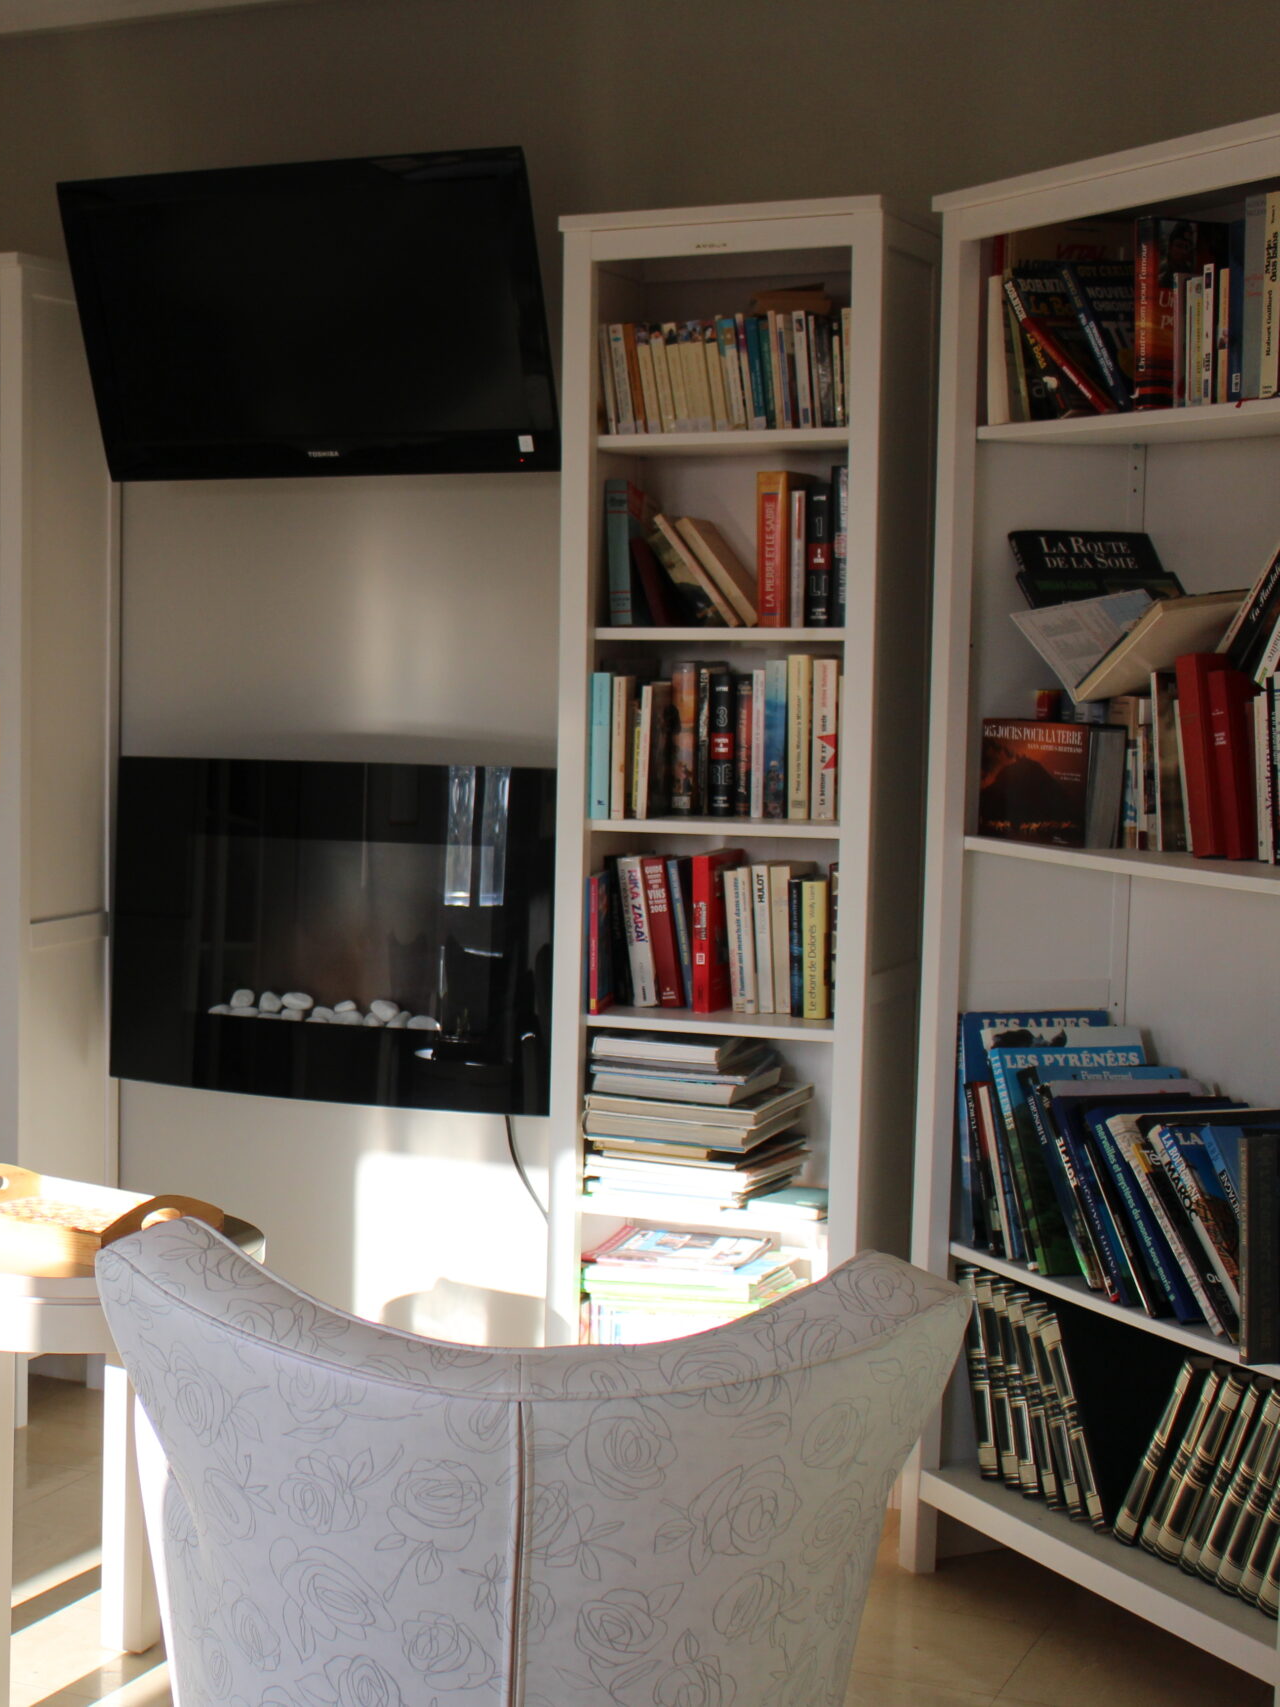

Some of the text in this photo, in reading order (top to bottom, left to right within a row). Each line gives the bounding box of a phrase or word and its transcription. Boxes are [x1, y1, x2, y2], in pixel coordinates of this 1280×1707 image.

[1137, 243, 1148, 279] l'amour
[1138, 282, 1149, 305] pour
[1138, 330, 1148, 356] autre
[765, 535, 775, 545] LE
[1040, 536, 1132, 554] LA ROUTE
[765, 547, 775, 558] ET
[1045, 553, 1139, 570] DE LA SOIE
[765, 593, 775, 608] LA
[998, 725, 1023, 740] JOURS
[1023, 727, 1044, 742] POUR
[1045, 729, 1056, 743] LA
[1056, 730, 1083, 746] TERRE
[628, 869, 640, 900] RIKA
[648, 888, 666, 900] VINS
[756, 873, 765, 903] HULOT
[650, 904, 668, 913] 2005
[807, 924, 817, 958] Dolorès
[807, 961, 816, 972] de
[807, 975, 816, 999] chant
[808, 1000, 816, 1012] Le
[1003, 1049, 1141, 1069] LES PYRÉNÉES
[1095, 1123, 1119, 1166] merveilles
[1162, 1133, 1201, 1203] LA BOURGOGNE
[1116, 1169, 1136, 1210] mystères
[1130, 1208, 1141, 1221] du
[1135, 1217, 1152, 1250] monde
[1148, 1243, 1172, 1292] sous-marin
